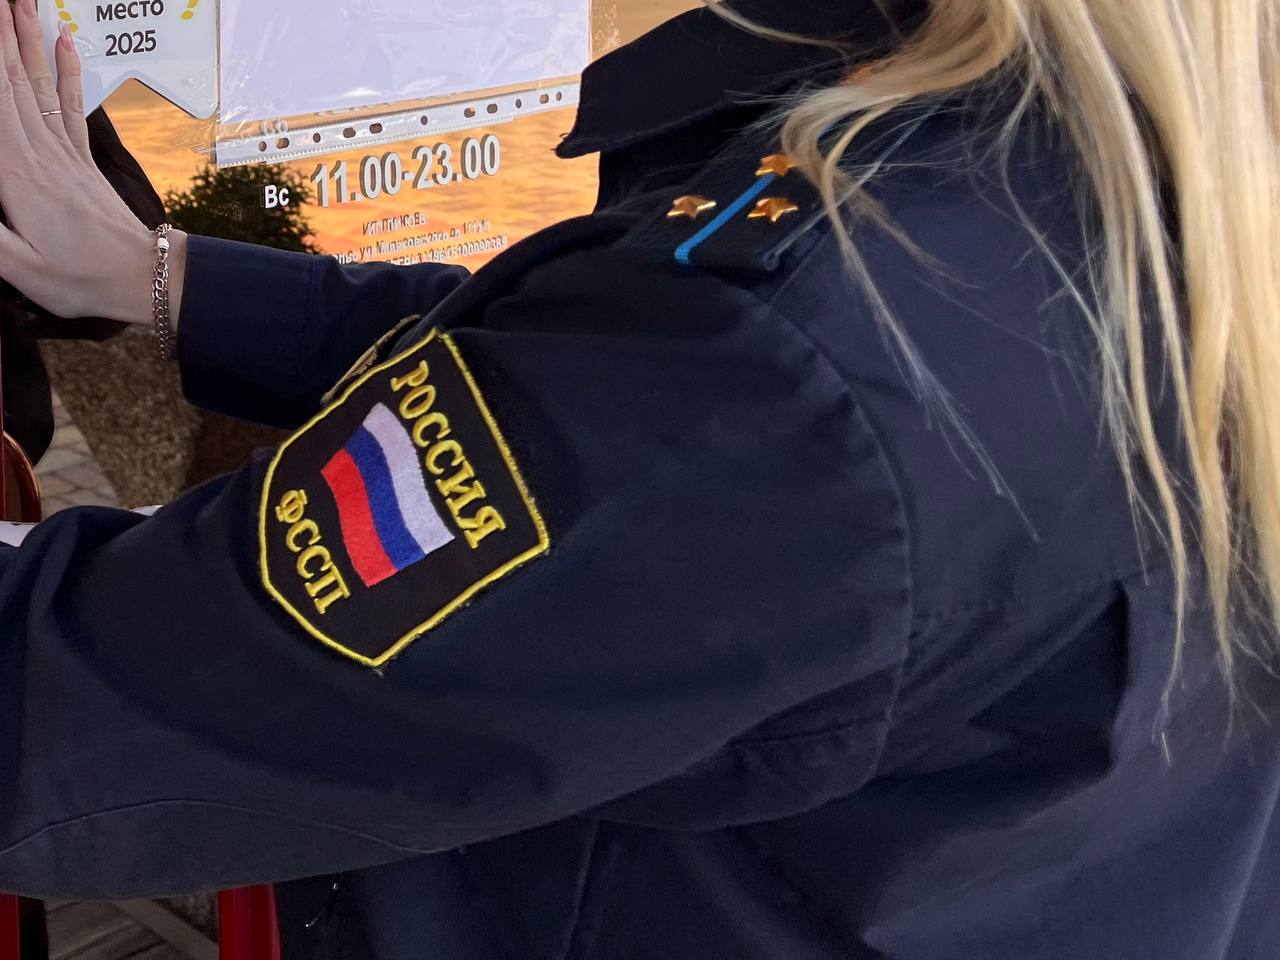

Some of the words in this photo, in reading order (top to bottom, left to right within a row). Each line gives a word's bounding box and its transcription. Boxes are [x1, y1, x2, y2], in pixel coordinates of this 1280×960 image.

[105, 29, 157, 57] 2025
[264, 185, 290, 208] Вс
[312, 133, 501, 207] 11.00-23.00
[390, 359, 506, 550] РОССИЯ
[275, 489, 351, 615] ФССП
